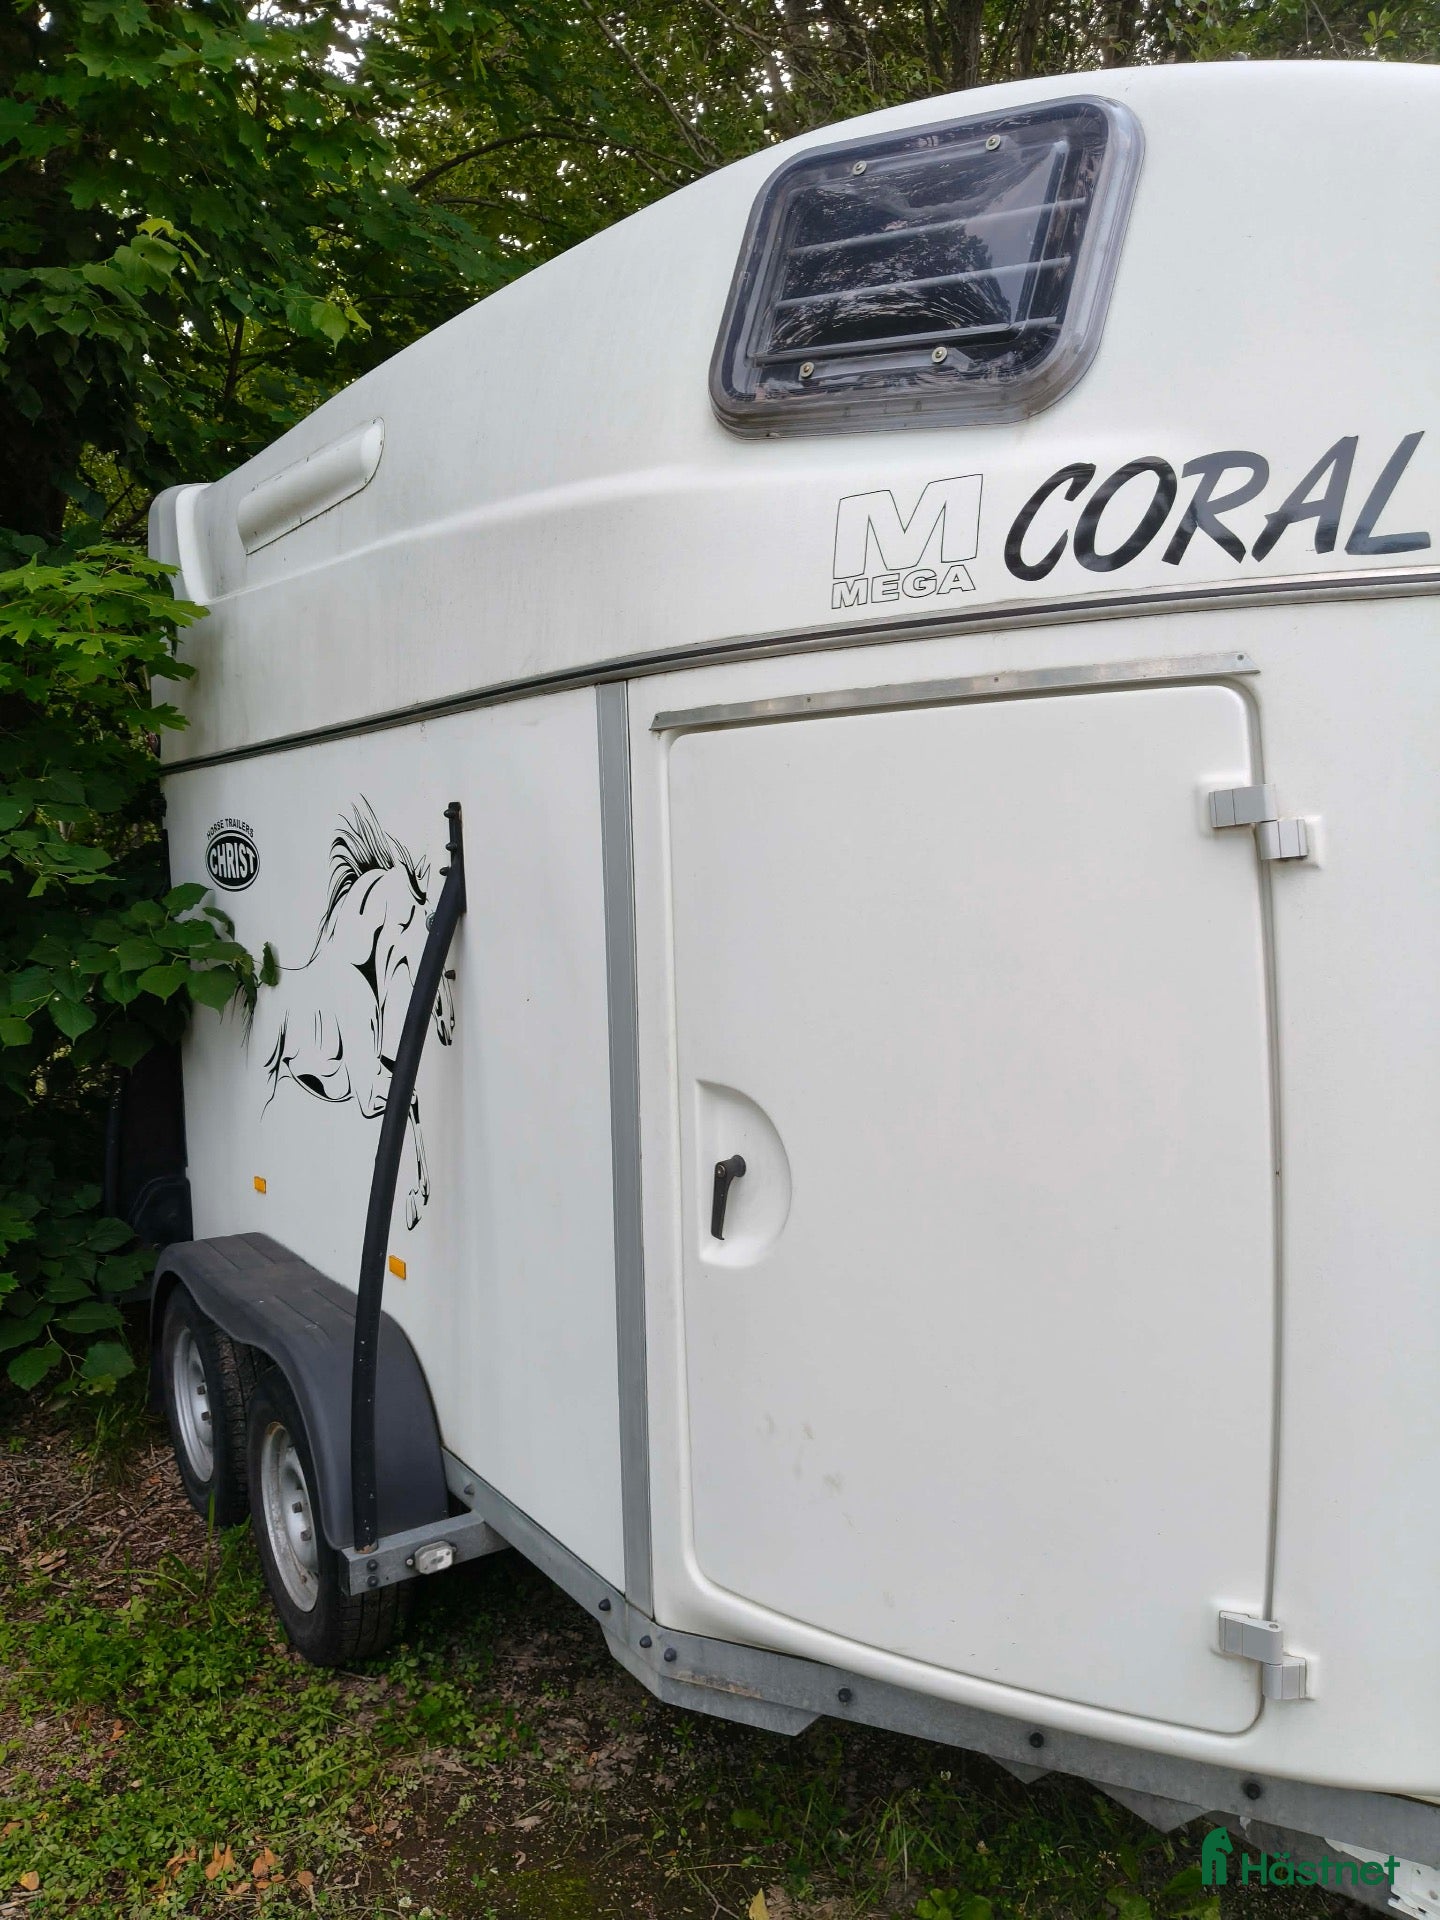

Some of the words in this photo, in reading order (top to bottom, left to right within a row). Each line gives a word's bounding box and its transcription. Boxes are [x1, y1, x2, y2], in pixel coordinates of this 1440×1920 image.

[833, 474, 983, 579] M
[1004, 431, 1431, 581] CORAL
[831, 565, 976, 609] MEGA
[206, 820, 224, 840] HORSE
[225, 818, 254, 838] TRAILERS
[209, 842, 256, 879] CHRIST
